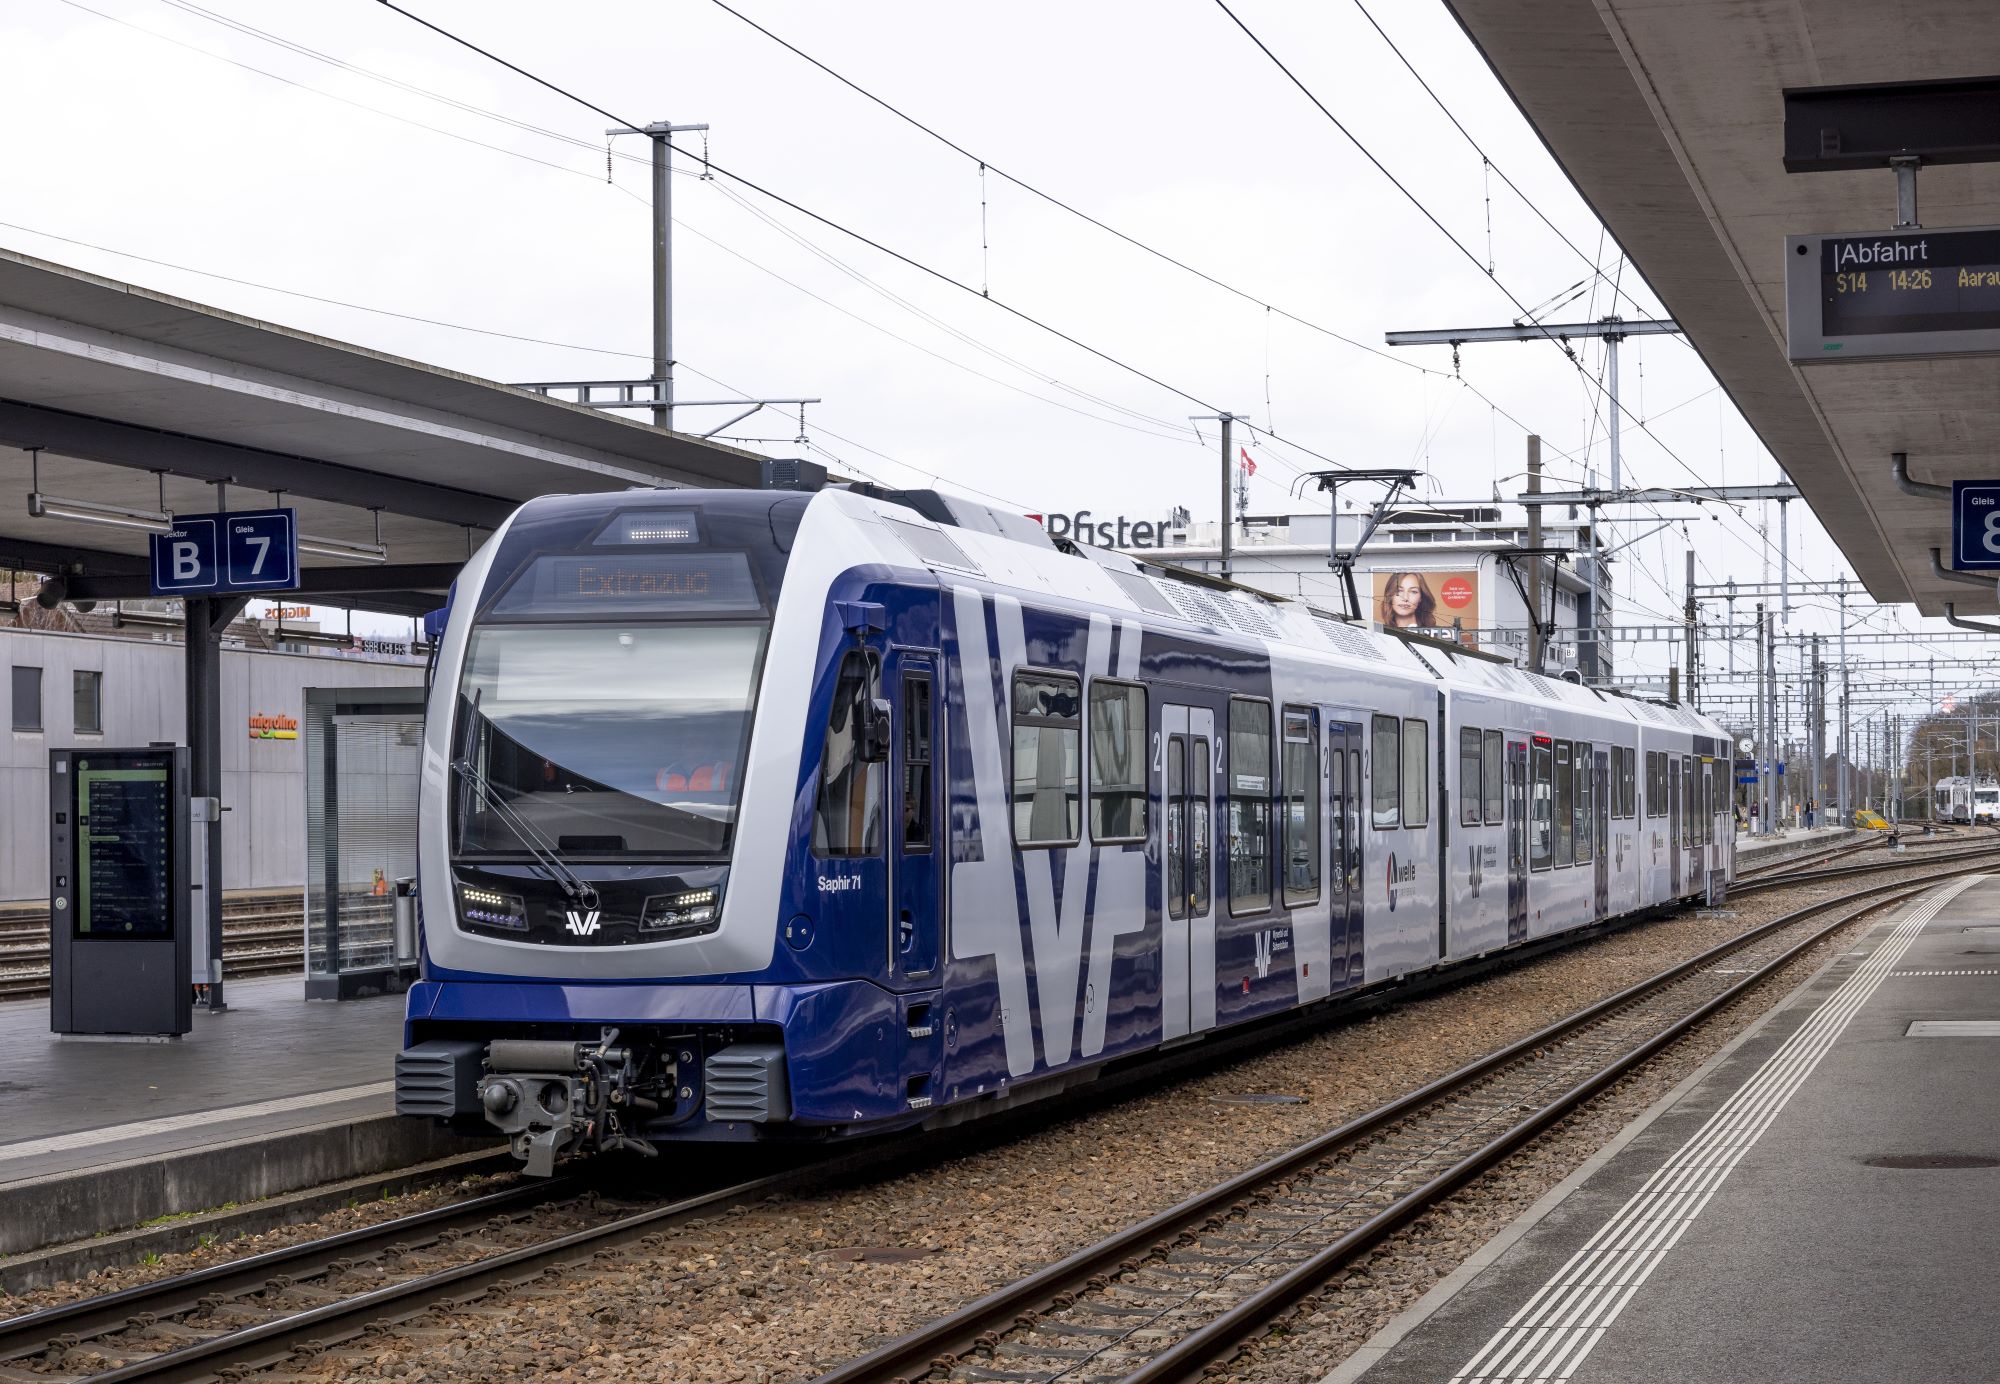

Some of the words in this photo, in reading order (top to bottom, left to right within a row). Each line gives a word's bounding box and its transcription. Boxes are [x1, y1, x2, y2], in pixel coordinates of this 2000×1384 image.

[1840, 240, 1928, 265] Abfahrt
[1836, 272, 1867, 293] S14
[1888, 269, 1932, 291] 14:26
[1971, 497, 1995, 505] Gleis
[235, 525, 254, 534] Gleis
[1048, 510, 1172, 549] Pfister
[1982, 510, 2000, 554] 8
[172, 541, 201, 580] B
[245, 536, 271, 575] 7
[364, 639, 379, 652] SBB
[249, 713, 298, 734] migrolino
[1153, 731, 1161, 772] 2
[1216, 736, 1223, 774] 2
[1323, 746, 1329, 778] 2
[1364, 749, 1369, 779] 2
[817, 875, 851, 893] Saphir
[851, 875, 861, 889] 71
